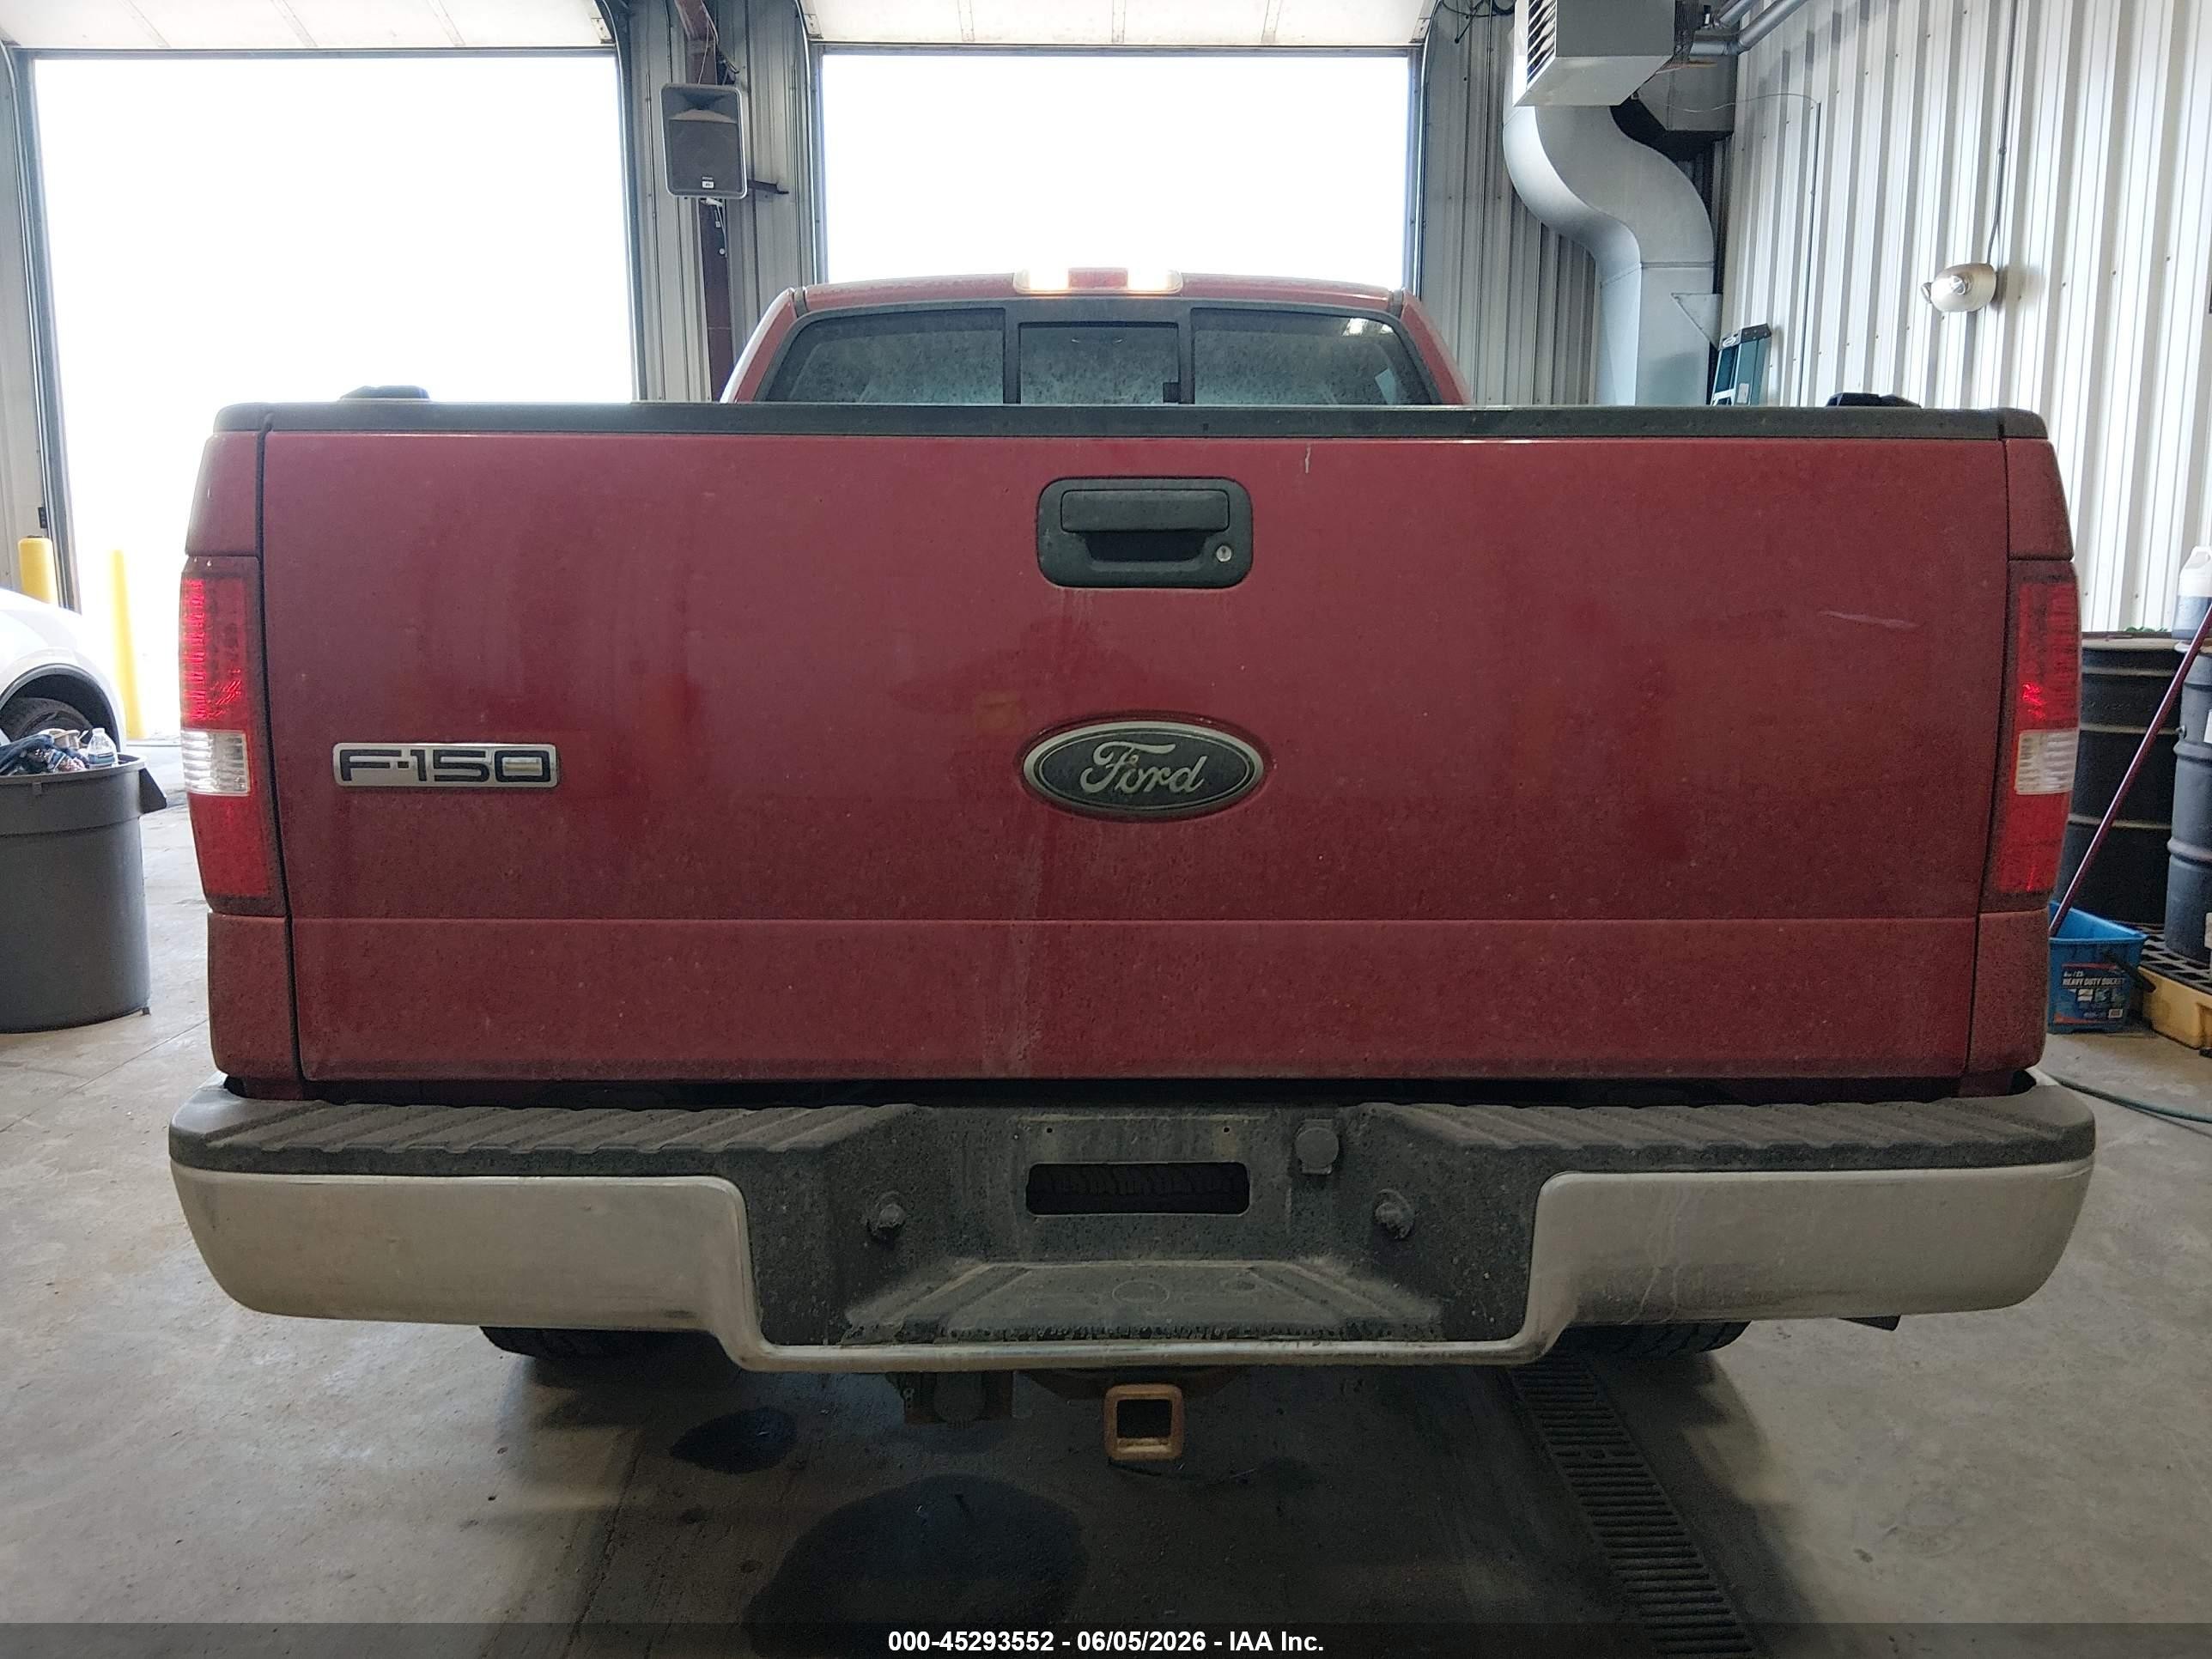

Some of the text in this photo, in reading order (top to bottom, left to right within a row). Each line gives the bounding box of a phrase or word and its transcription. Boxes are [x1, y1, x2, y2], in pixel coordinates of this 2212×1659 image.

[339, 749, 552, 783] F-150
[1079, 740, 1208, 794] Ford
[2084, 977, 2101, 986] DUTY
